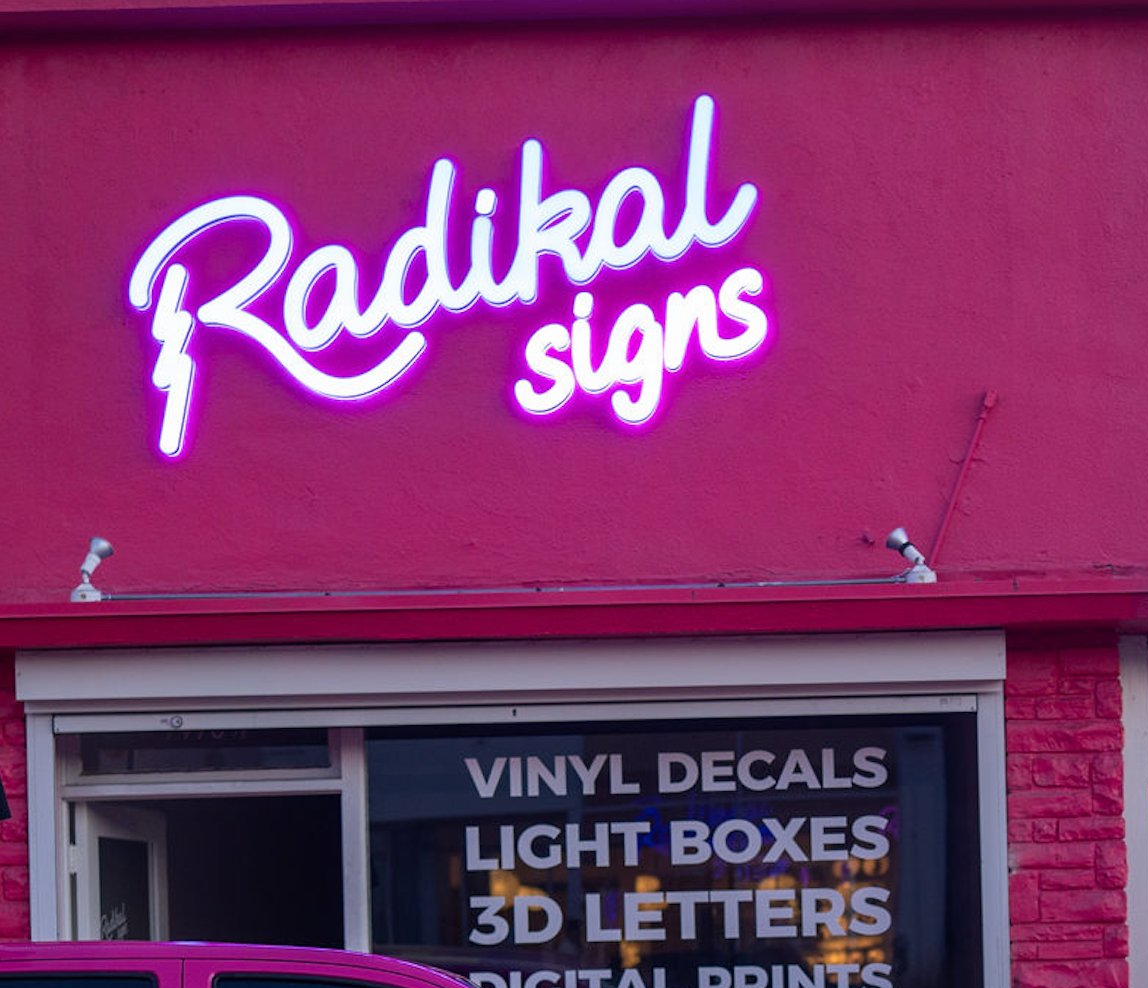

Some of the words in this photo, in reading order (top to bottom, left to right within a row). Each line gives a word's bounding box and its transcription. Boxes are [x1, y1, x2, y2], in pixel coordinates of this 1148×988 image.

[129, 95, 757, 456] Radikal
[514, 267, 768, 424] signs
[465, 753, 640, 798] VINYL
[657, 747, 888, 794] DECALS
[466, 822, 650, 871] LIGHT
[670, 815, 890, 865] BOXES
[469, 893, 563, 945] 3D
[585, 887, 891, 942] LETTERS
